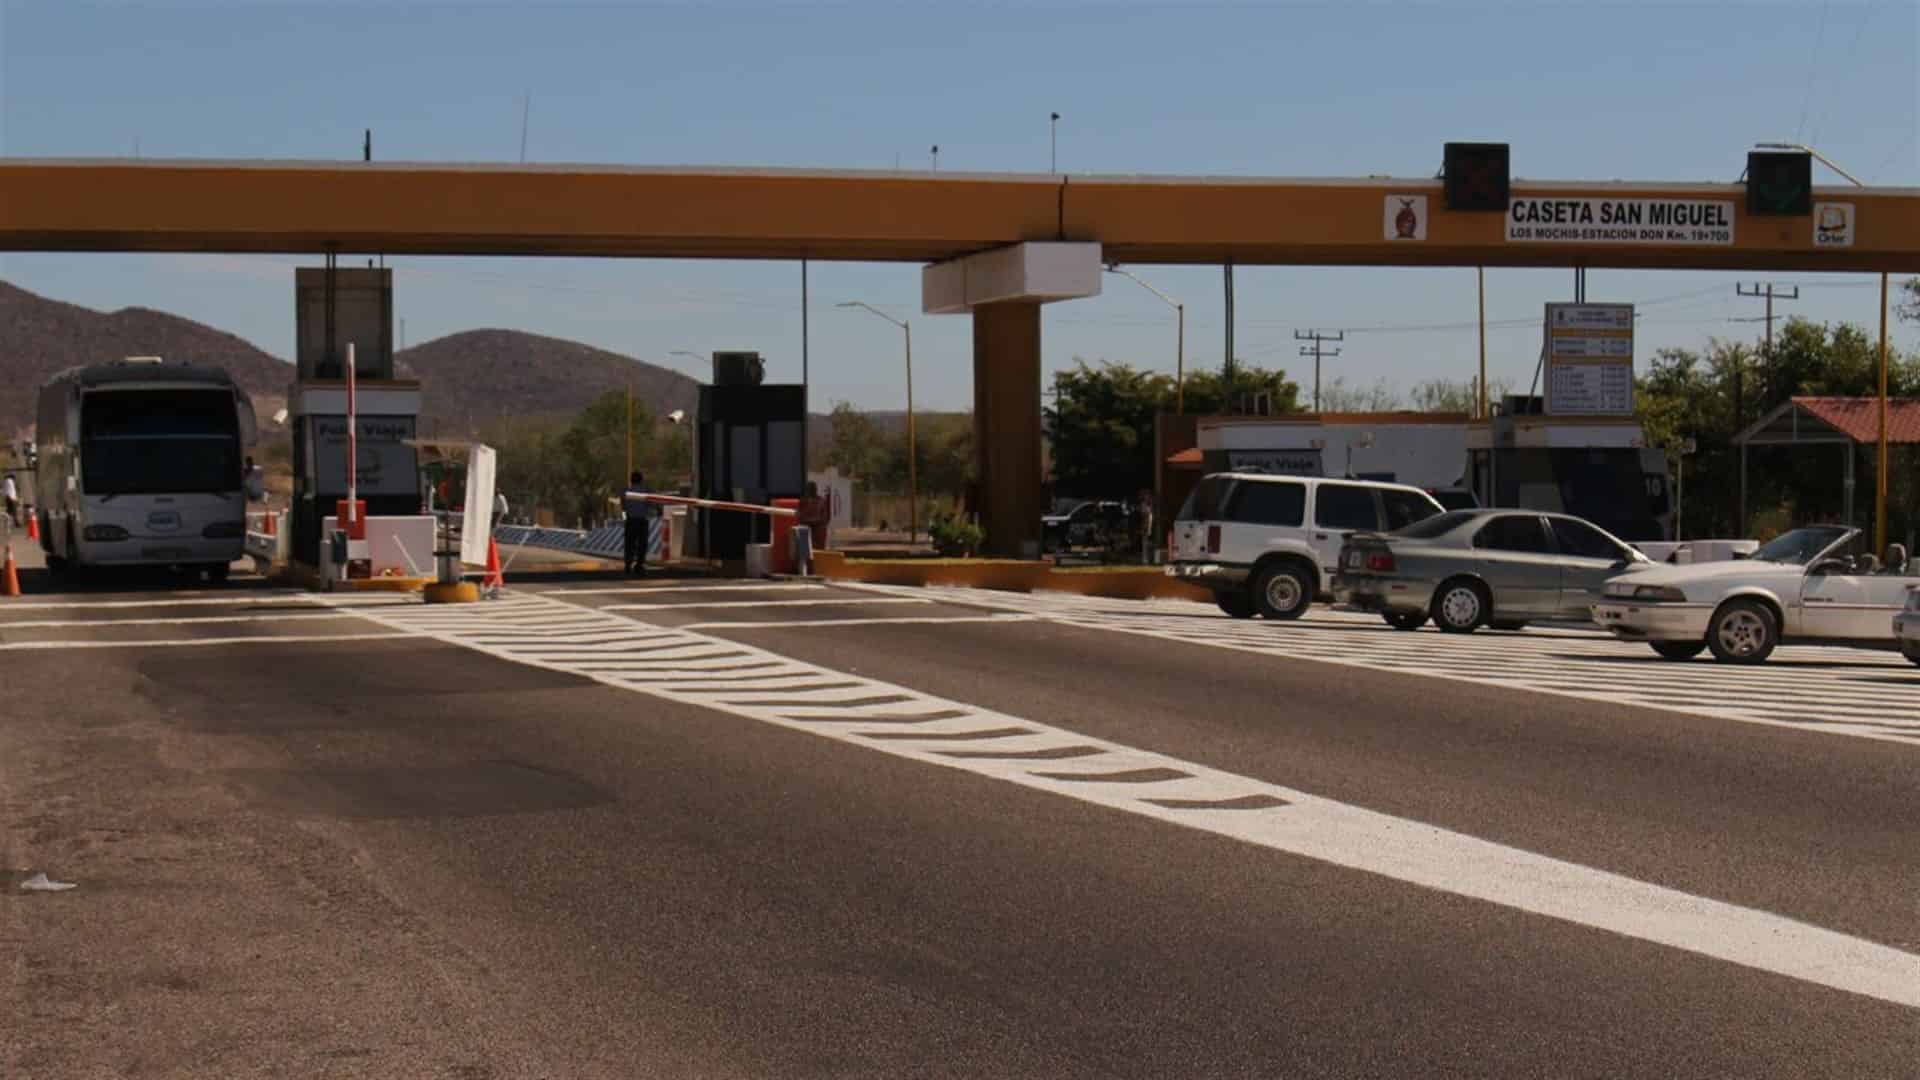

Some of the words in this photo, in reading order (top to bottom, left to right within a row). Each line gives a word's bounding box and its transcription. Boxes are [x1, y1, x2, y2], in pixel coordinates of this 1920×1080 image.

[1512, 201, 1593, 224] CASETA
[1600, 203, 1641, 225] SAN
[1649, 203, 1729, 227] MIGUEL
[1510, 227, 1532, 239] LOS
[1640, 229, 1664, 240] DON
[1645, 477, 1662, 497] 10
